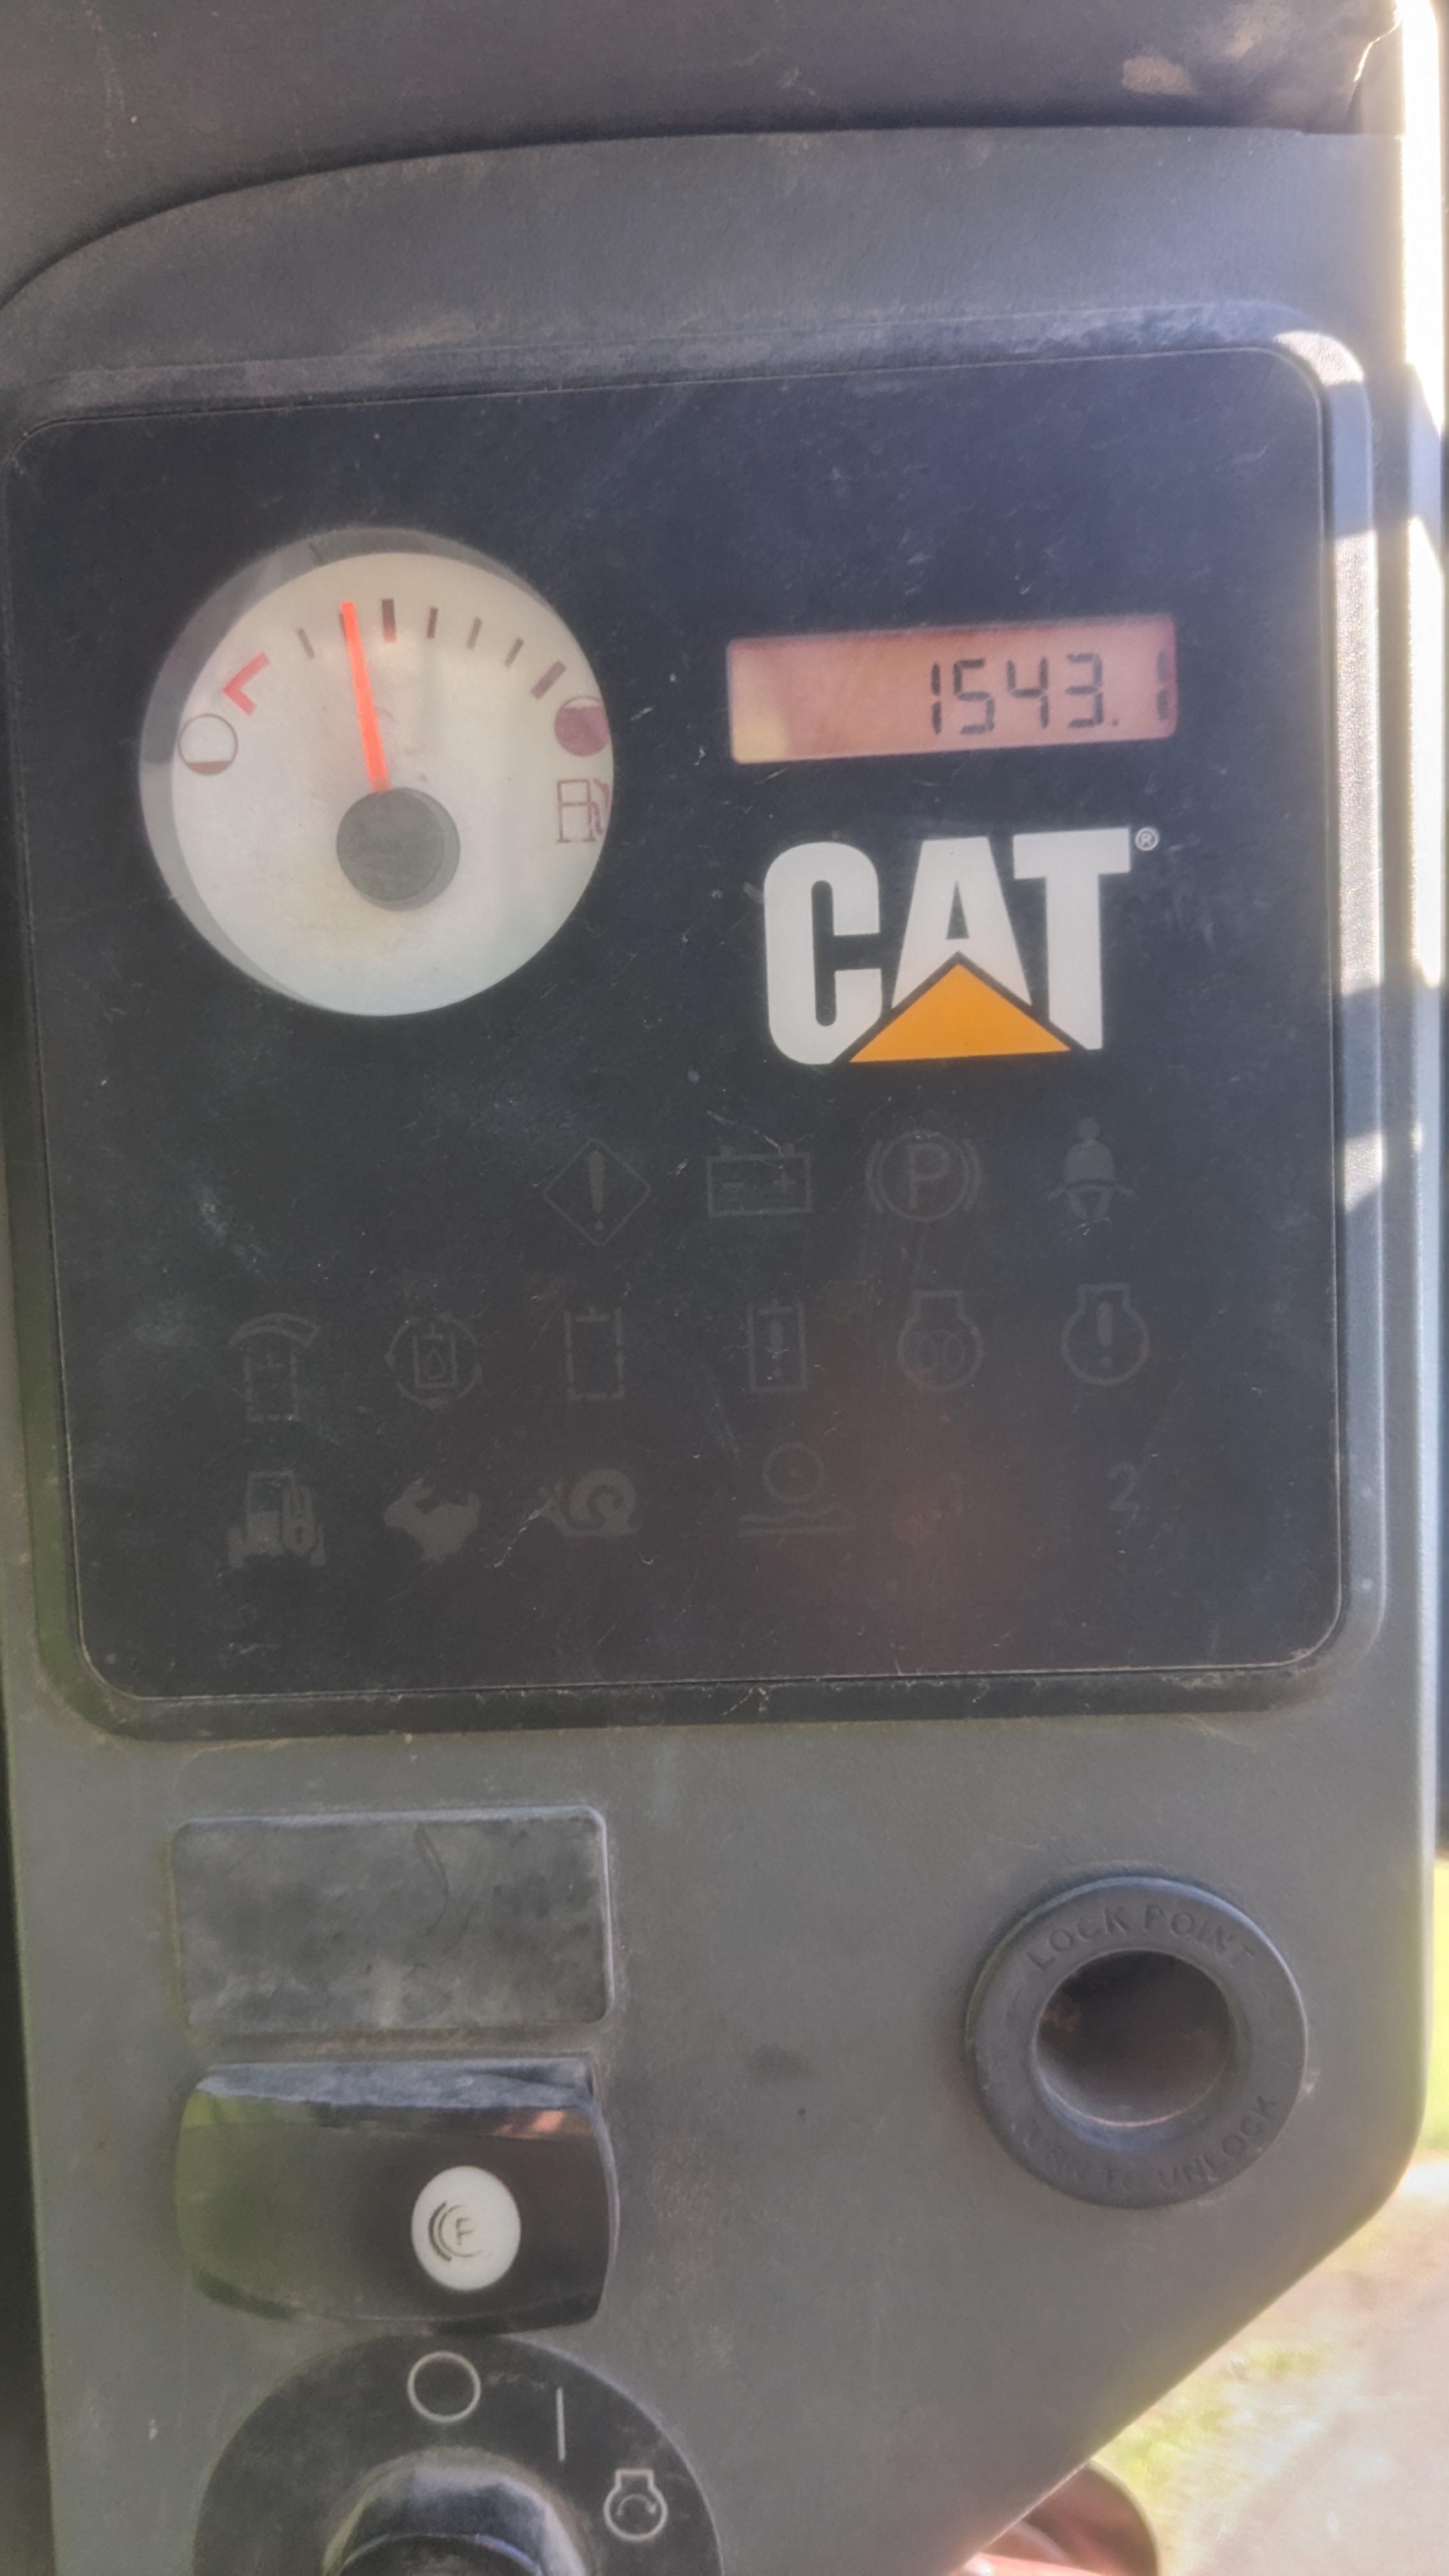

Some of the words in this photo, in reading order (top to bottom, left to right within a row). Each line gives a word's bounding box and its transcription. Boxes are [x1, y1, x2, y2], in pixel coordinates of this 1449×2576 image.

[931, 651, 1169, 735] 1543.1
[1108, 1462, 1140, 1512] 2
[1026, 1905, 1130, 1972] LOCK
[1144, 1903, 1255, 1969] POINT
[1160, 2094, 1278, 2188] UNLOCK
